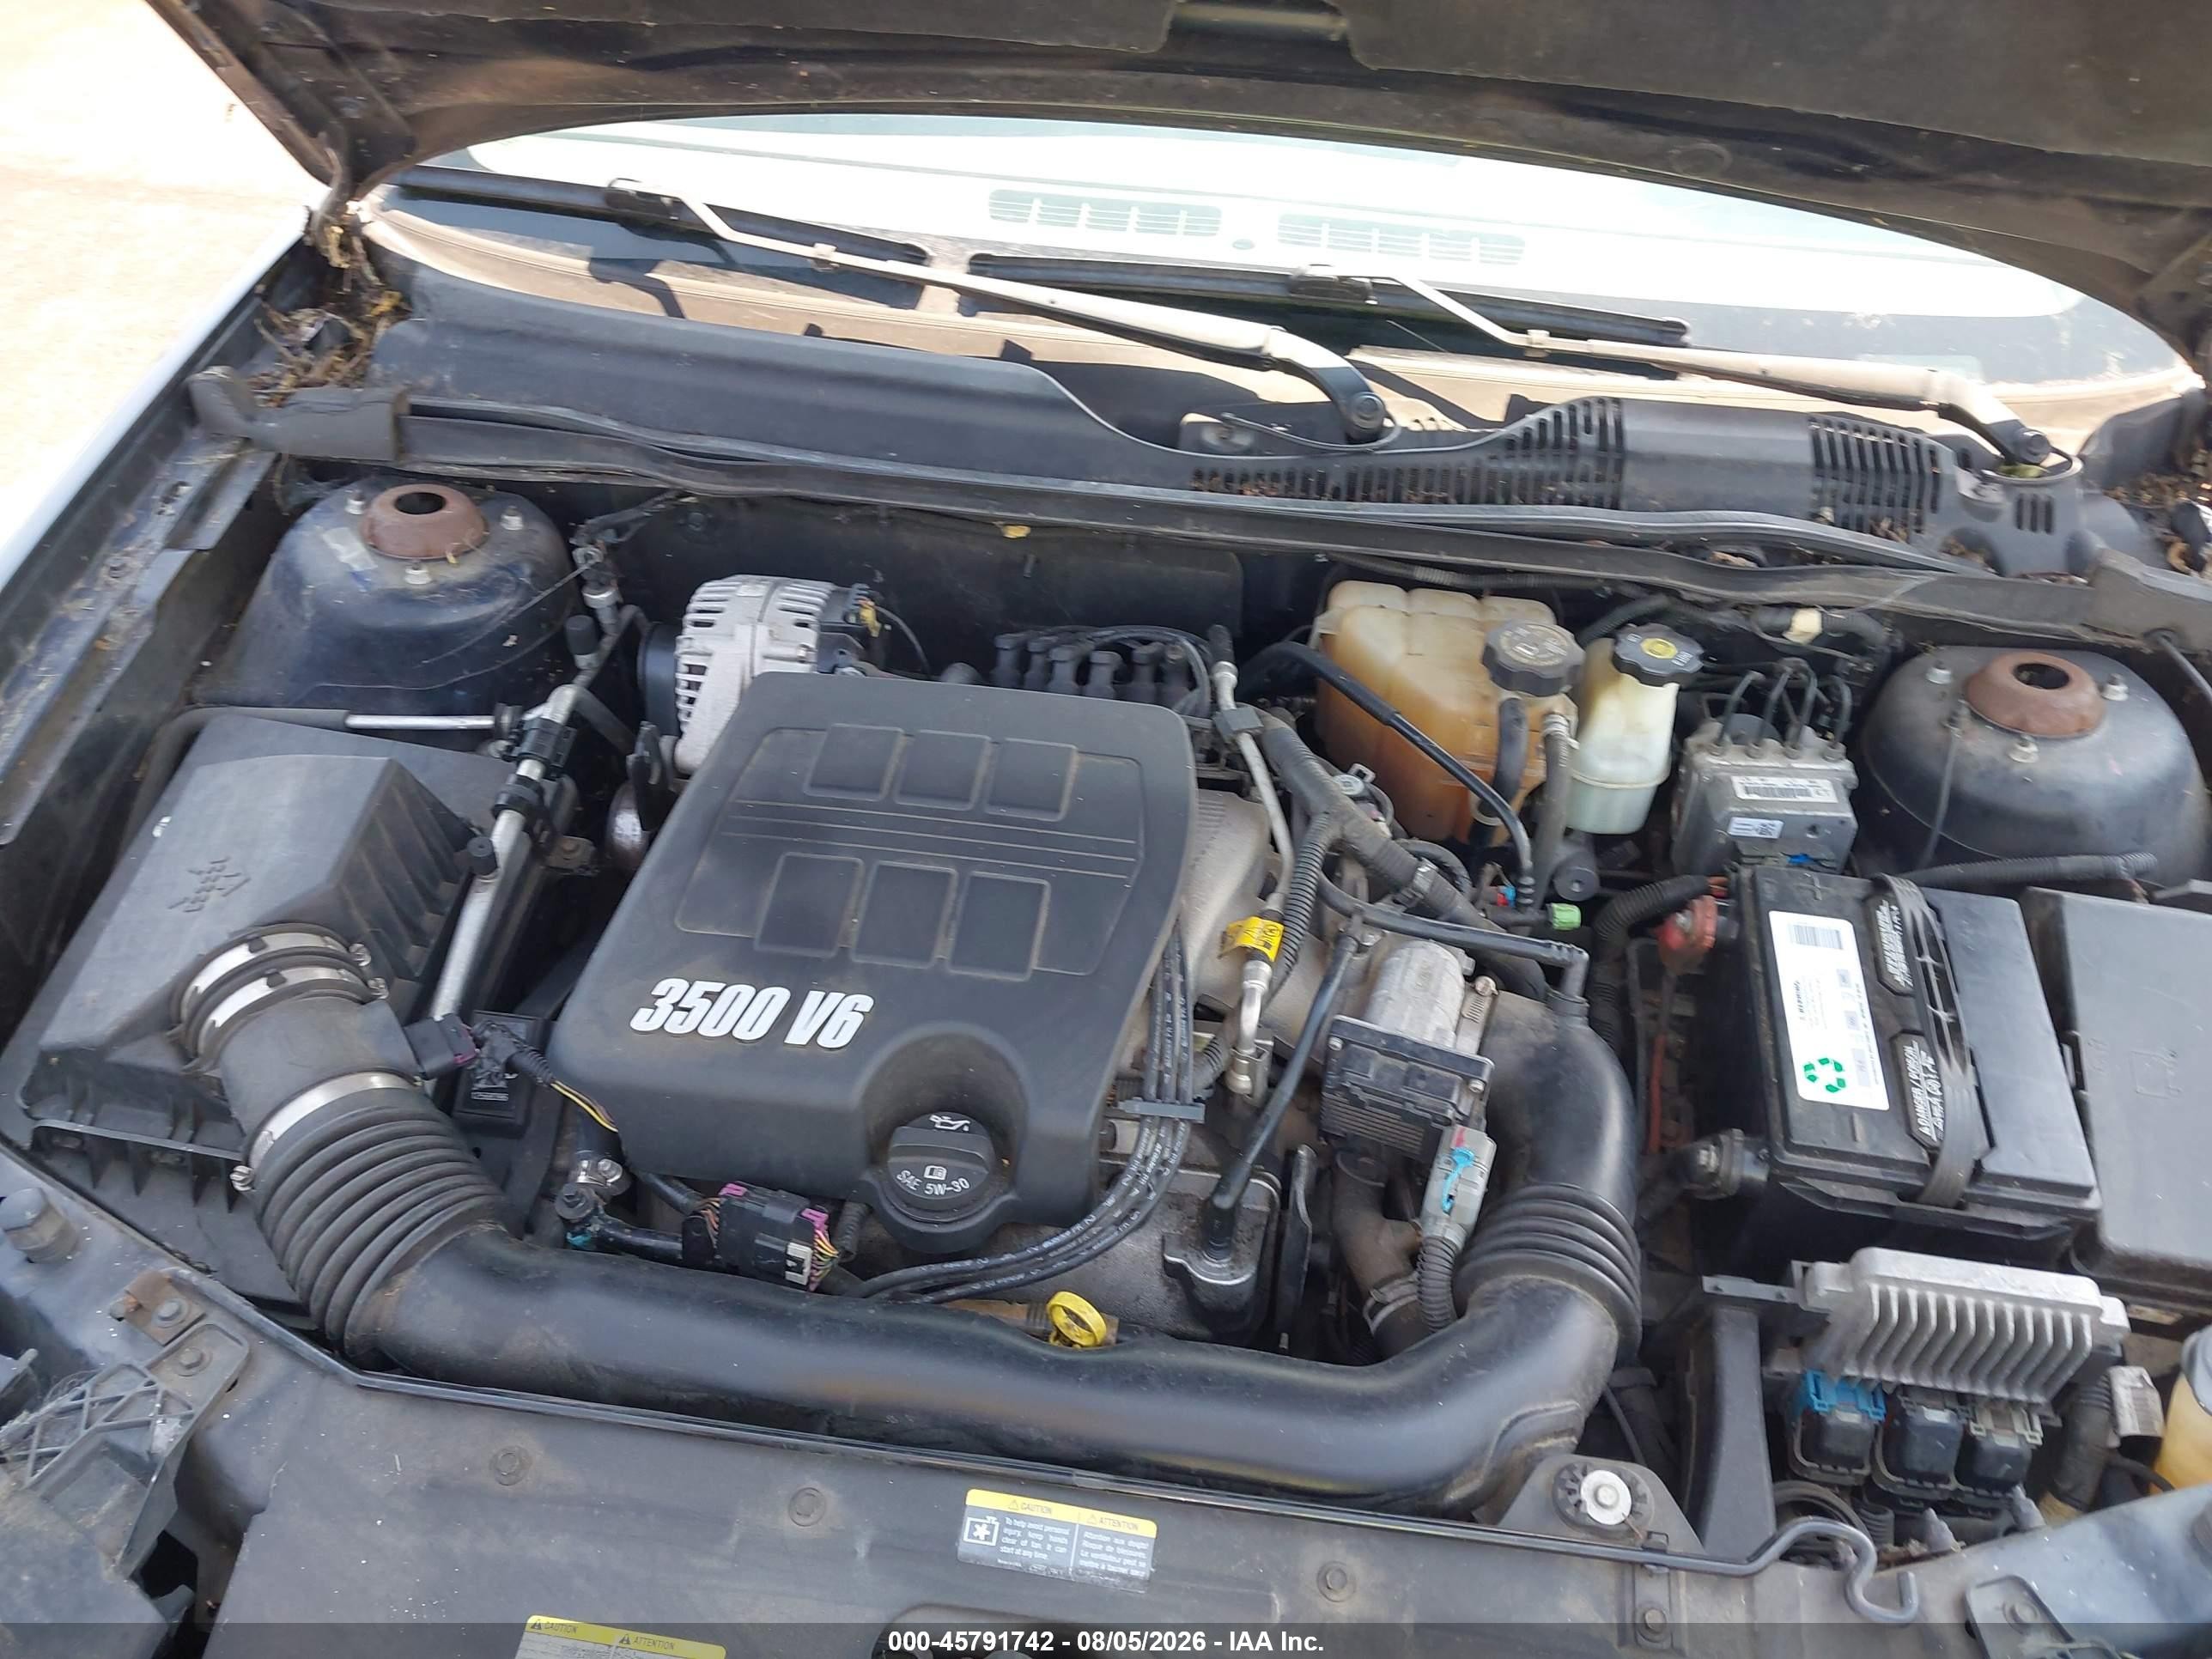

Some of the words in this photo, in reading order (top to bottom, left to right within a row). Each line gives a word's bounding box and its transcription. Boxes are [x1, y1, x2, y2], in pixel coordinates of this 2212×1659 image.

[629, 977, 791, 1042] 3500
[783, 989, 874, 1049] V6
[896, 1169, 923, 1191] SAE
[923, 1176, 970, 1195] 5W-30
[1020, 1501, 1053, 1515] CAUTION
[1098, 1516, 1140, 1531] ATTENTION
[544, 1620, 578, 1634] CAUTION
[632, 1636, 675, 1651] ATTENTION
